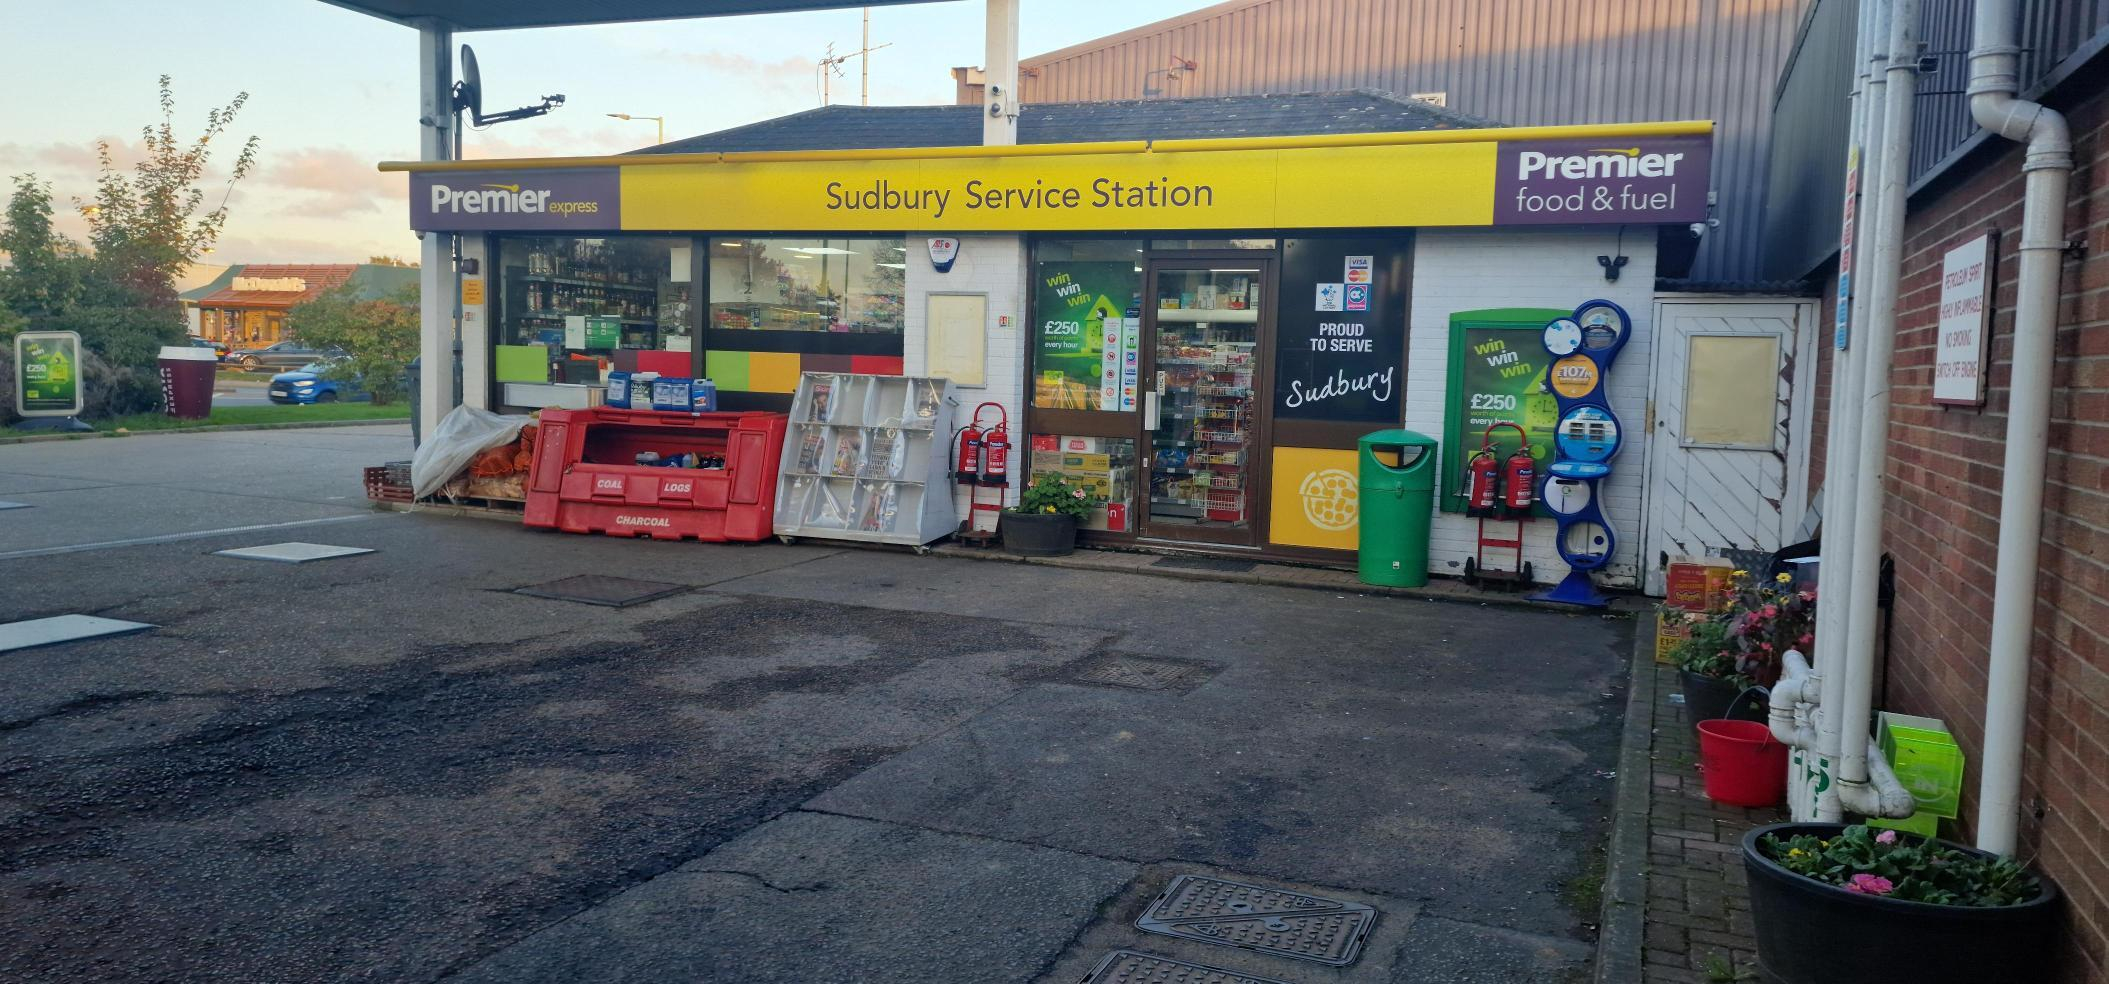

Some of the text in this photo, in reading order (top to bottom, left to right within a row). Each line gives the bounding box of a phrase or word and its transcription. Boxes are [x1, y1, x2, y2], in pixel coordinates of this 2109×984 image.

[1519, 148, 1684, 180] Premier
[431, 184, 598, 218] Premier express
[826, 177, 1213, 218] Sudbury Service Station
[1516, 183, 1676, 212] food & fuel
[1046, 272, 1071, 287] win
[1056, 282, 1081, 298] win
[1066, 293, 1091, 307] win
[1044, 320, 1079, 335] £250
[1319, 323, 1365, 337] PROUD
[1044, 342, 1062, 350] every
[1310, 338, 1373, 352] TO SERVE
[1473, 338, 1506, 355] win
[1945, 332, 1952, 348] NO
[1486, 350, 1519, 367] win
[26, 364, 47, 372] £250
[1500, 362, 1532, 378] win
[1285, 366, 1394, 408] Sudbury
[1470, 393, 1517, 411] £250
[1470, 418, 1493, 427] every
[597, 479, 623, 489] COAL
[664, 483, 691, 493] LOGS
[615, 515, 671, 527] CHARCOAL
